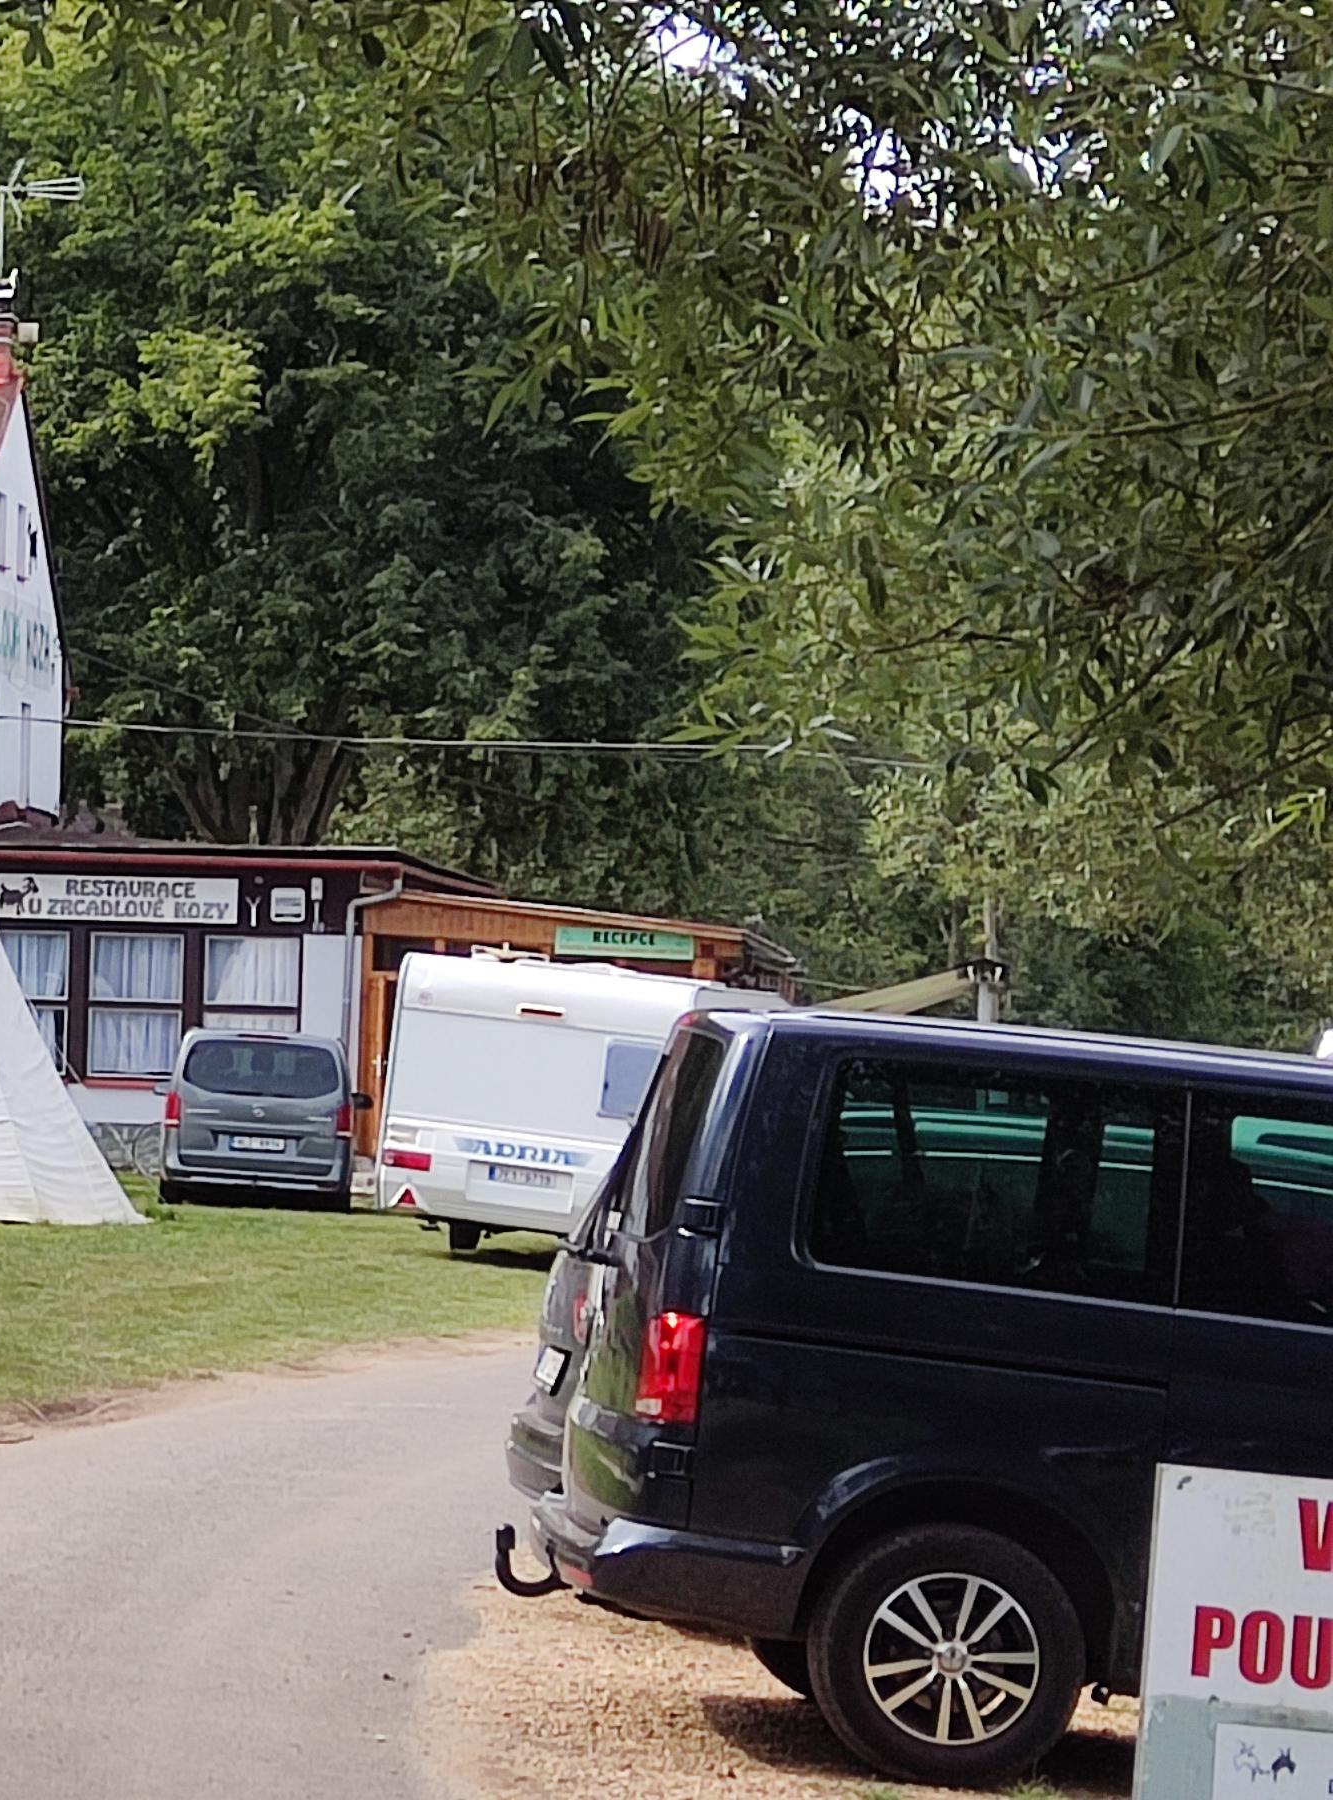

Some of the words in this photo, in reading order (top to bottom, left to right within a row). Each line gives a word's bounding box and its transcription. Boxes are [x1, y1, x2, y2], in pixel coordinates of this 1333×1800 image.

[66, 879, 196, 898] RESTAURACE
[29, 899, 41, 914] U
[47, 898, 165, 918] ZRCADLOVÉ
[174, 901, 229, 919] KOZY
[593, 931, 656, 946] RECEPCE
[472, 1140, 572, 1165] ADRIA
[1191, 1605, 1333, 1690] POU
